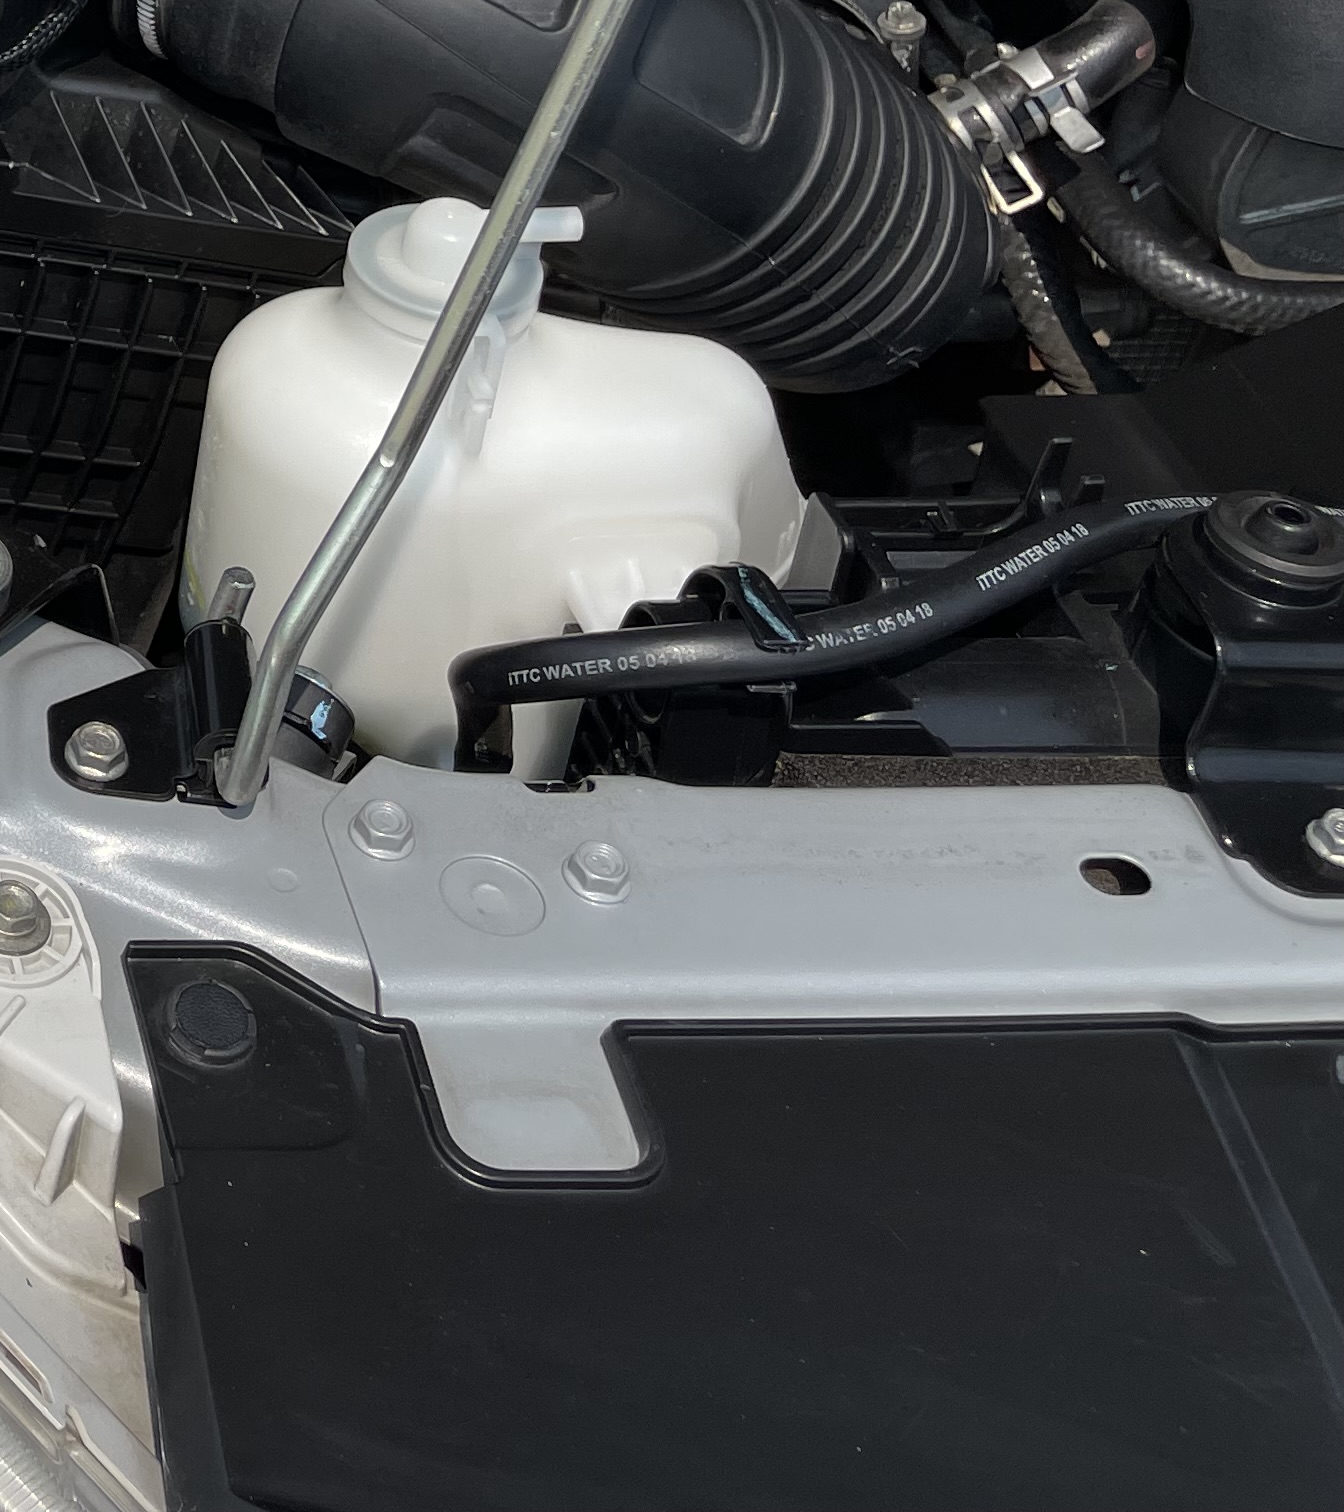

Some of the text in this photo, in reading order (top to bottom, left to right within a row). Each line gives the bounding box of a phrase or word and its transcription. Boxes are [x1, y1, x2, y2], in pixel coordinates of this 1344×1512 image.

[1151, 496, 1200, 510] WATER
[1000, 544, 1048, 576] WATER
[1042, 536, 1061, 553] 05
[1056, 529, 1076, 546] 04
[1071, 523, 1090, 539] 18
[877, 617, 897, 635] 05
[896, 609, 916, 628] 04
[915, 602, 934, 620] 18
[542, 658, 613, 681] WATER
[617, 655, 640, 671] 05
